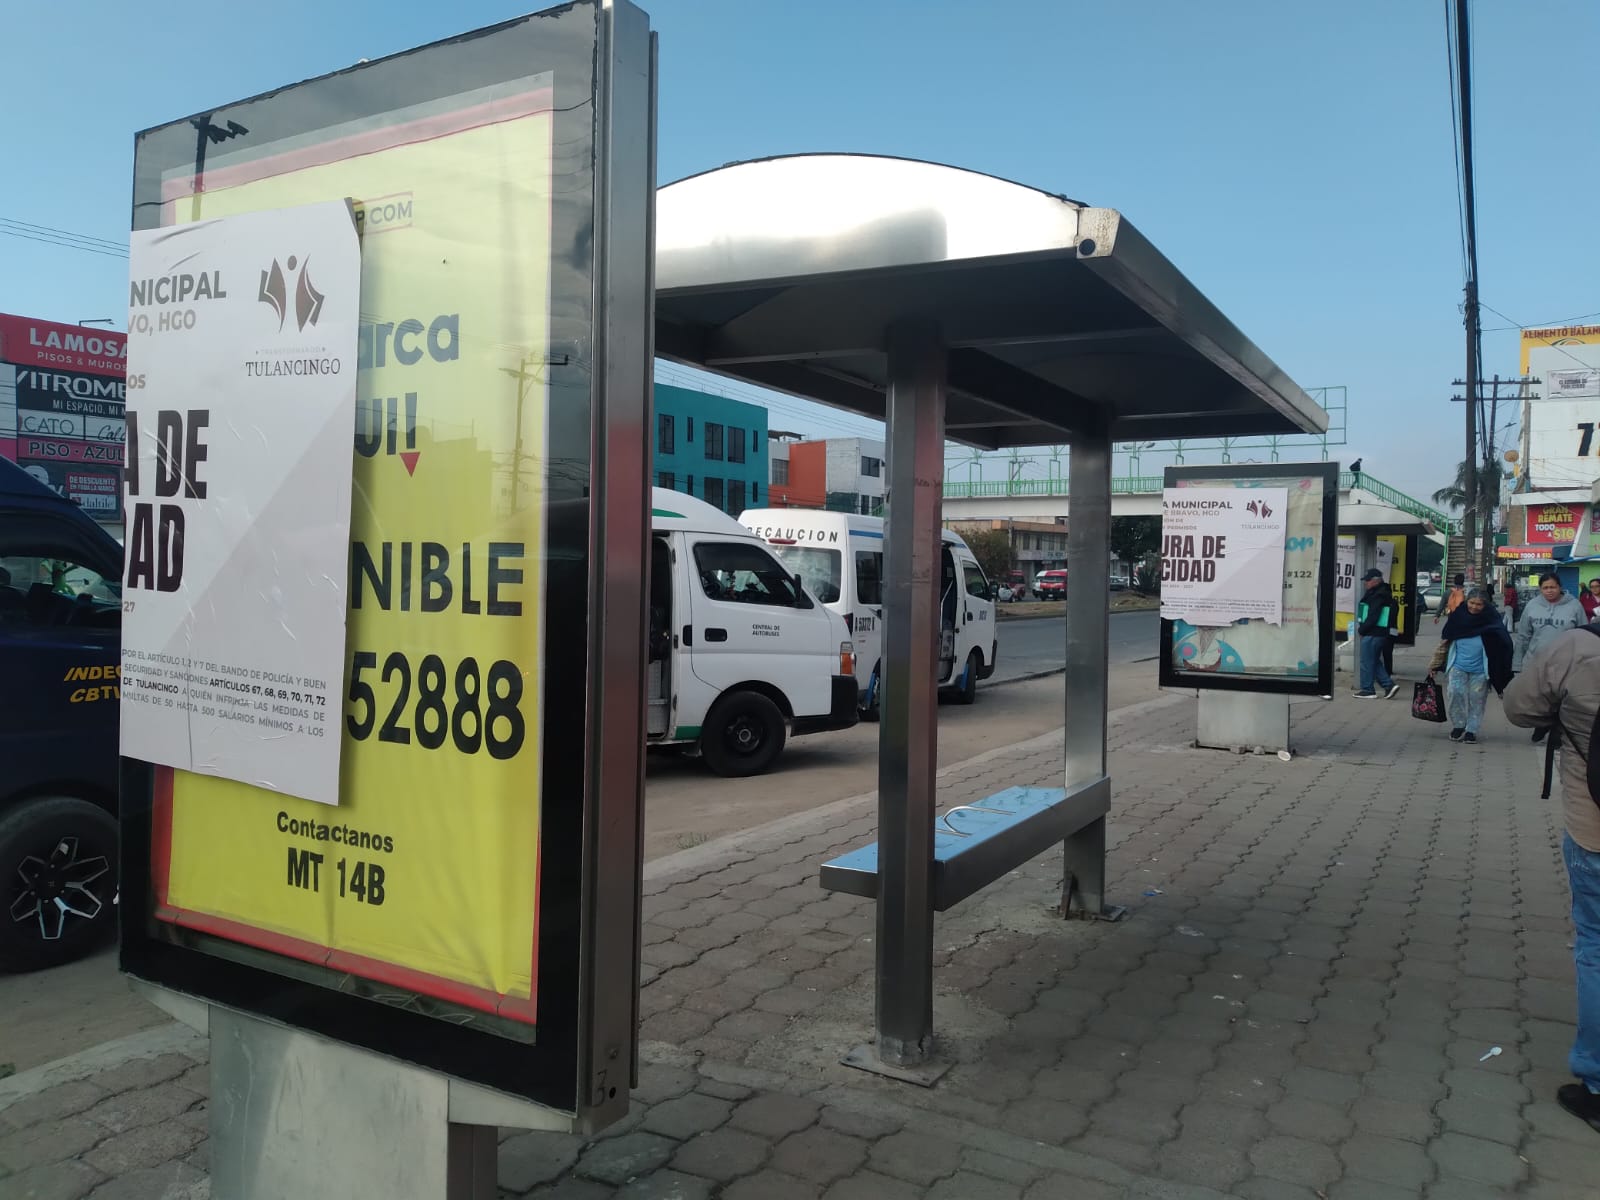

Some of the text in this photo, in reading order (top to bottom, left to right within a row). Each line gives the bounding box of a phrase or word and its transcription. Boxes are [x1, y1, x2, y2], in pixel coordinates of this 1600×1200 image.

[130, 270, 227, 307] NICIPAL
[159, 309, 196, 331] HGO
[37, 351, 72, 363] PISOS
[77, 357, 83, 366] &
[245, 358, 341, 377] TULANCINGO
[53, 399, 63, 409] MI
[29, 442, 70, 457] PISO
[155, 409, 210, 499] DE
[1172, 500, 1233, 510] MUNICIPAL
[1538, 514, 1573, 523] REMATE
[124, 503, 185, 592] AD
[1202, 535, 1227, 559] DE
[350, 541, 525, 616] NIBLE
[1161, 559, 1216, 583] CIDAD
[124, 601, 135, 613] 27
[122, 648, 137, 658] POR
[138, 651, 145, 660] EL
[200, 661, 205, 669] 7
[205, 662, 219, 672] DEL
[221, 665, 248, 677] BANDO
[250, 670, 261, 680] DE
[263, 671, 294, 685] POLICÍA
[296, 677, 301, 685] Y
[303, 678, 326, 690] BUEN
[124, 663, 162, 677] SEGURIDAD
[209, 678, 250, 693] ARTÍCULOS
[252, 685, 263, 697] 67,
[264, 687, 276, 699] 68,
[278, 690, 289, 701] 69,
[291, 692, 303, 703] 70,
[304, 694, 314, 706] 71,
[316, 695, 326, 706] 72
[123, 677, 133, 686] DE
[135, 679, 179, 694] TULANCINGO
[253, 701, 268, 712] LAS
[272, 704, 309, 719] MEDIDAS
[313, 711, 325, 722] DE
[152, 696, 162, 706] DE
[218, 709, 255, 724] SALARIOS
[307, 725, 324, 737] LOS
[346, 651, 525, 760] 52888
[277, 811, 394, 853] Contactanos
[288, 846, 385, 906] MT 14B
